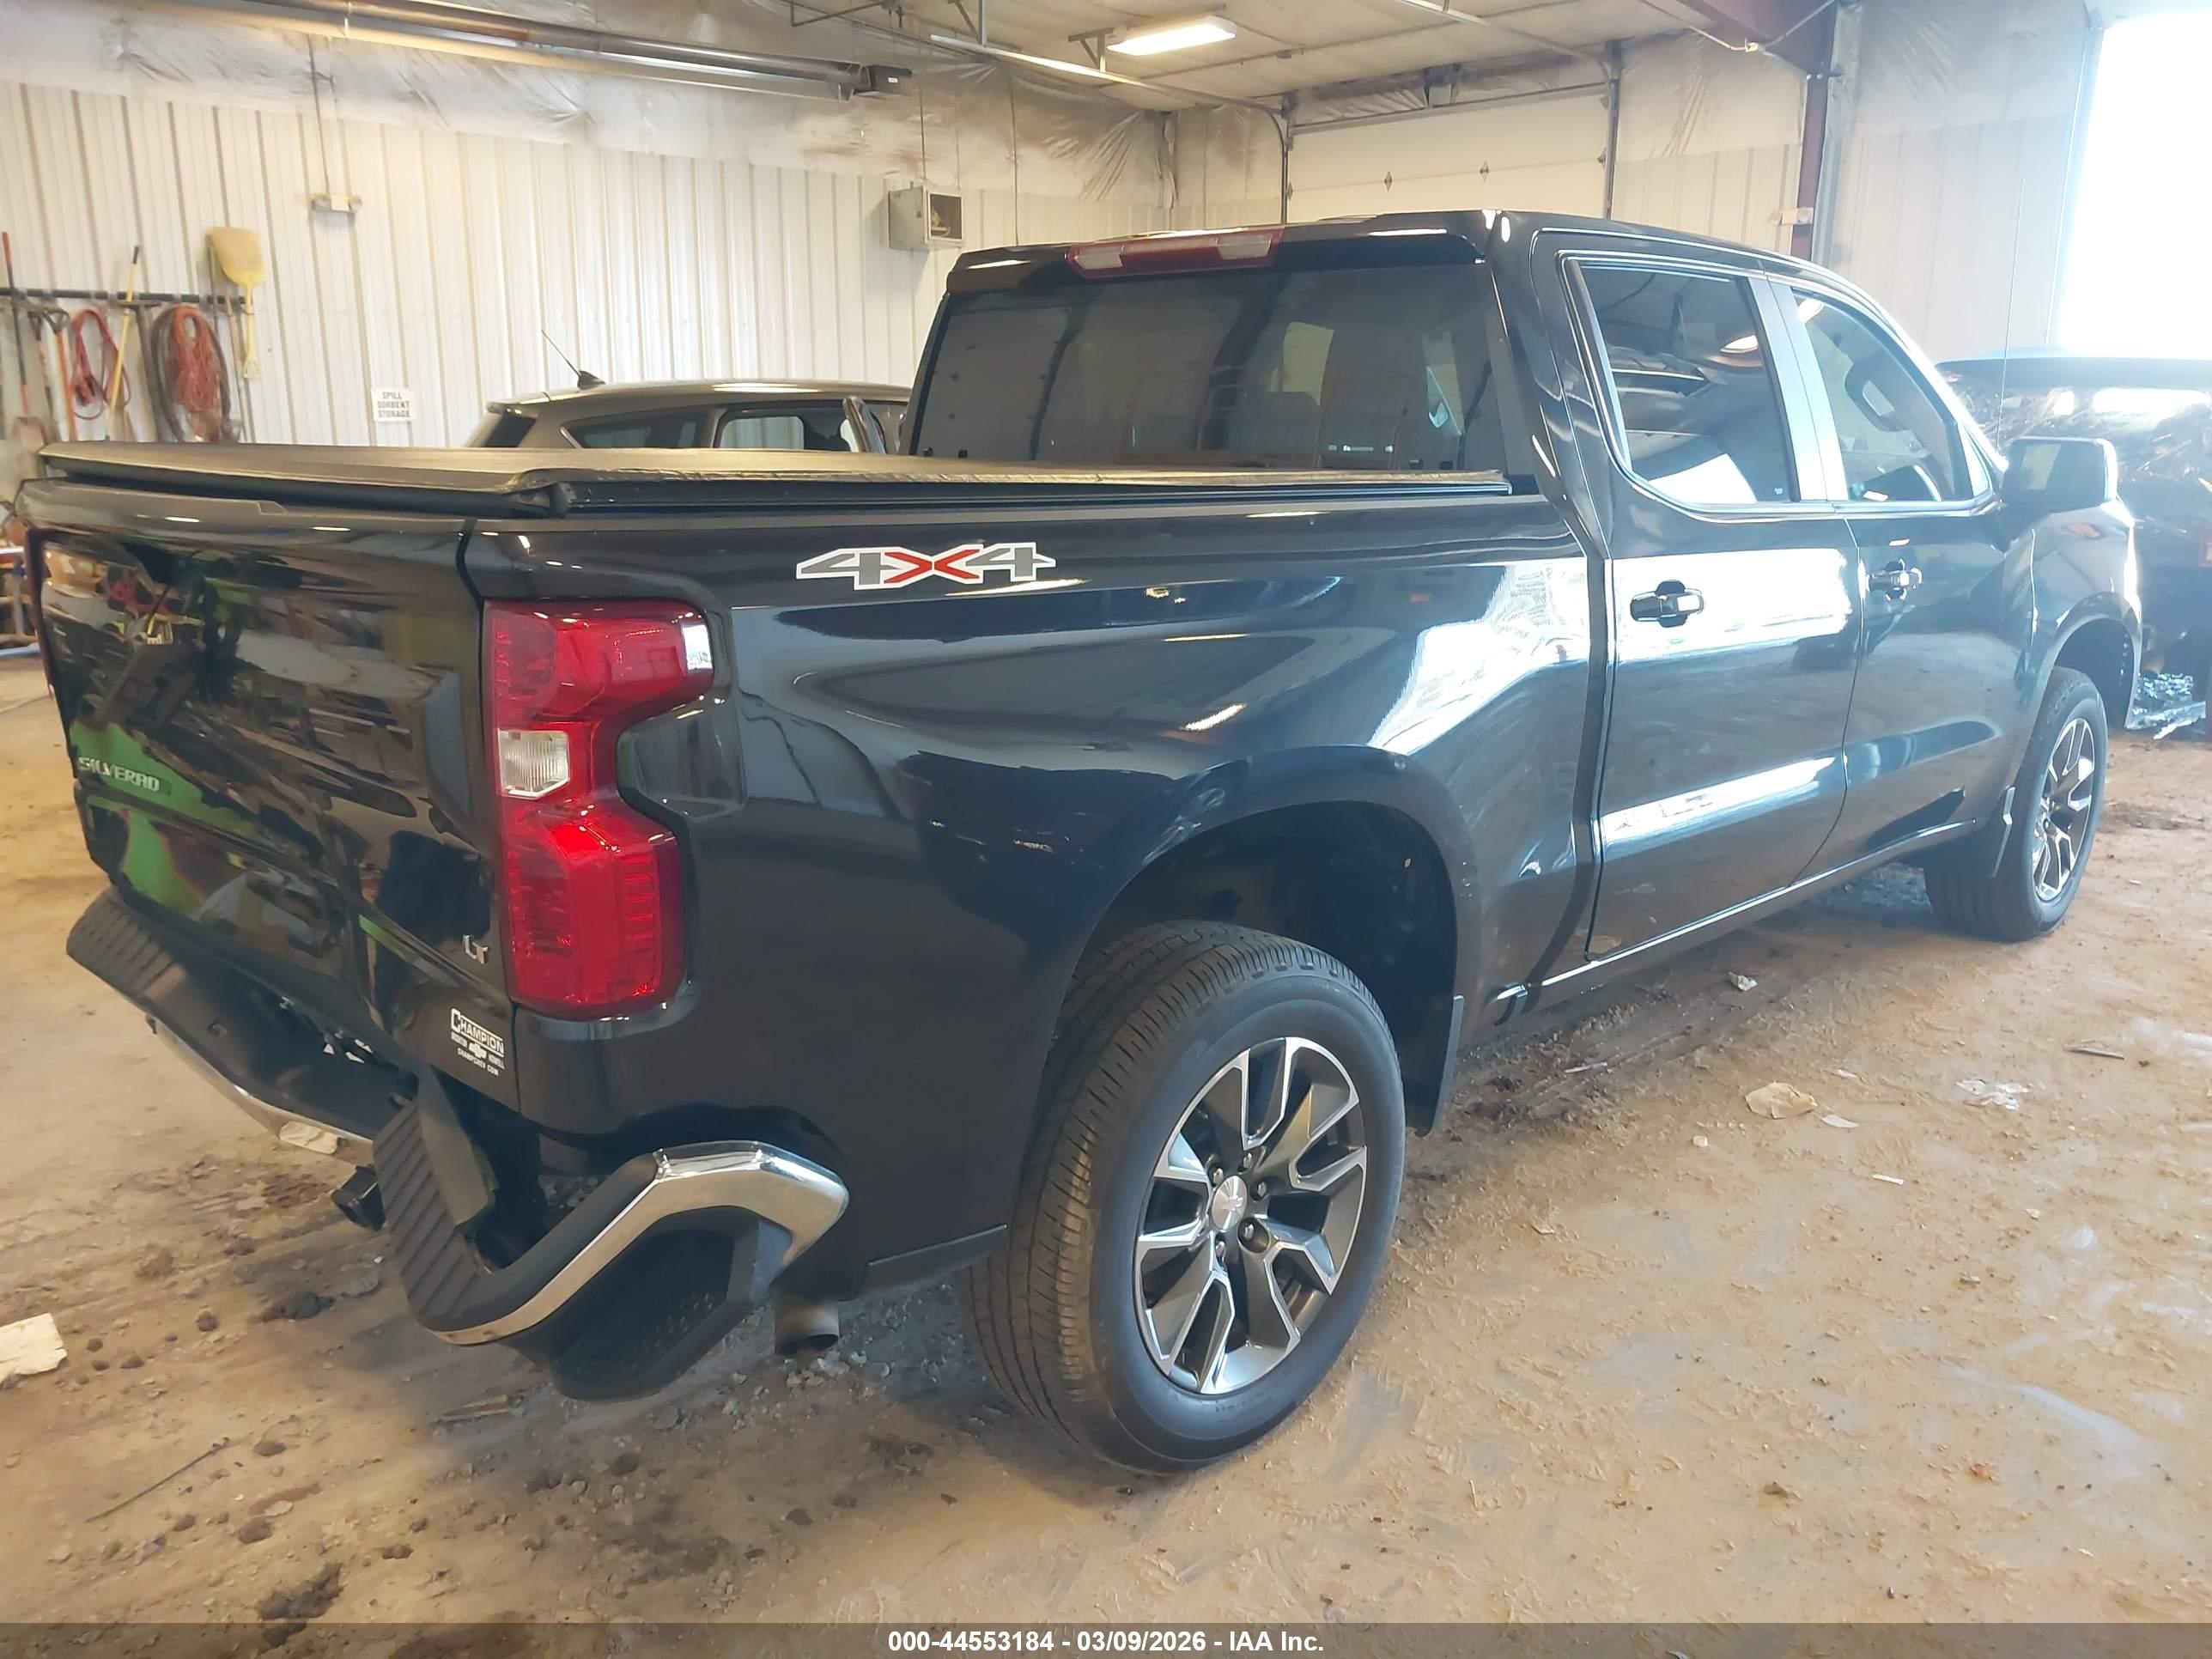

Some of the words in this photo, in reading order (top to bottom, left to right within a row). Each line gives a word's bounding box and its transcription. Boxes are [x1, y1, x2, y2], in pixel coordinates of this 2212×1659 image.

[378, 410, 410, 418] STORAGE
[463, 934, 489, 963] LT
[451, 1008, 504, 1054] CHAMPION
